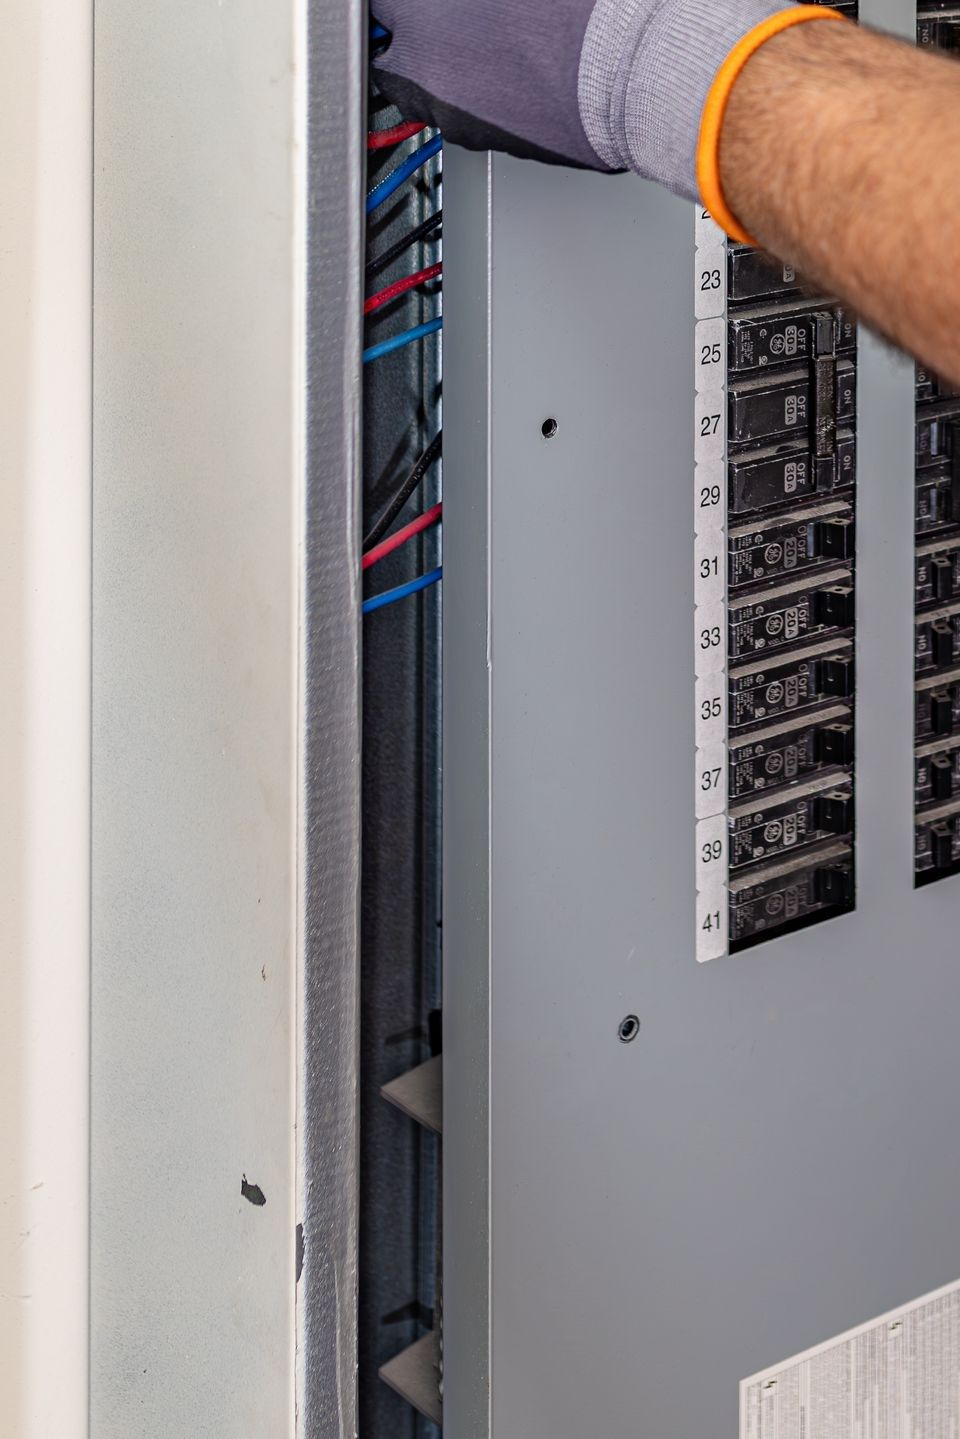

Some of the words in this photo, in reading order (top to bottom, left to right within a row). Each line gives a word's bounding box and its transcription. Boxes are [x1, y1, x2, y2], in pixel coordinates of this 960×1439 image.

[700, 269, 721, 291] 23
[797, 328, 806, 351] OFF
[701, 343, 721, 366] 25
[797, 396, 806, 418] OFF
[843, 389, 852, 405] ON
[700, 413, 721, 437] 27
[797, 462, 805, 485] OFF
[843, 455, 852, 470] ON
[700, 485, 721, 508] 29
[700, 555, 718, 579] 31
[700, 626, 721, 650] 33
[701, 696, 722, 721] 35
[701, 767, 722, 791] 37
[702, 839, 722, 863] 39
[702, 910, 720, 932] 41
